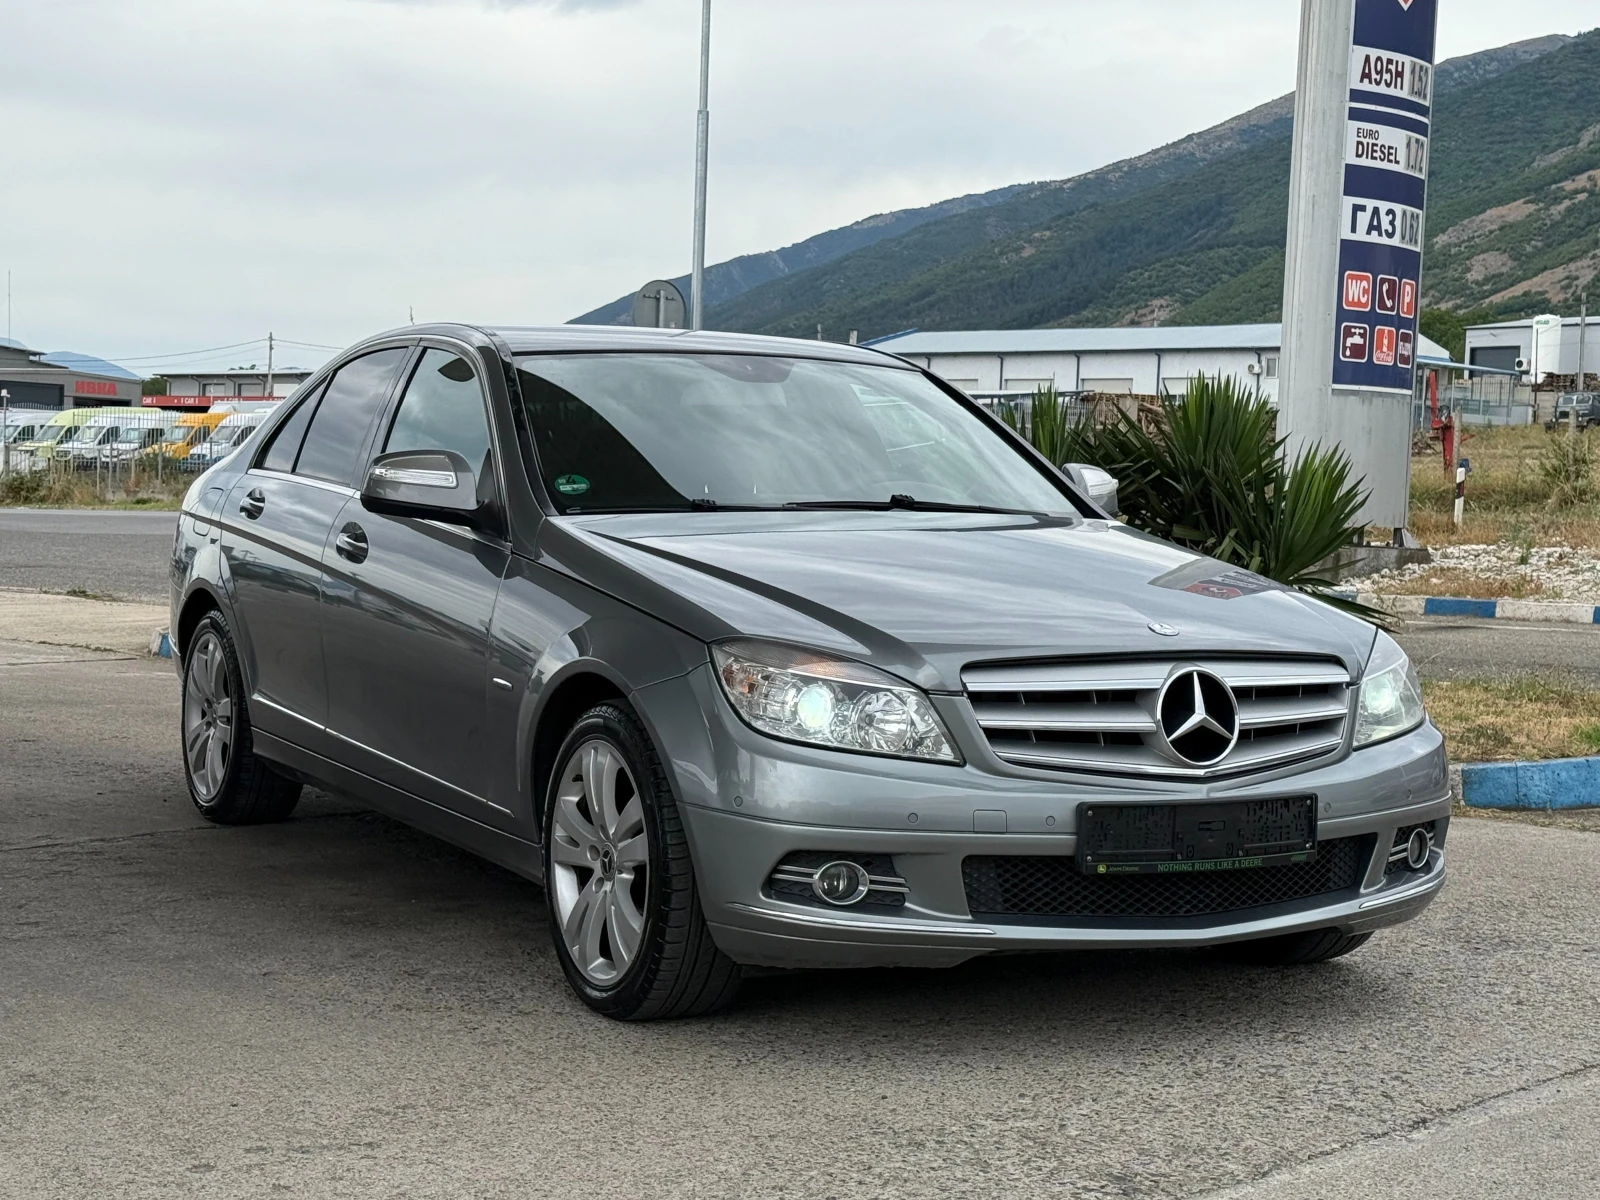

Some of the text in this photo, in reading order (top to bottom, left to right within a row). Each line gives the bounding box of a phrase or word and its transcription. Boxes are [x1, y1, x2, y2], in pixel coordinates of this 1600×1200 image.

[1356, 127, 1380, 141] EURO
[1355, 141, 1400, 165] DIESEL
[1350, 203, 1397, 239] ГАЗ
[1347, 279, 1368, 304] WC
[1157, 858, 1263, 872] NOTHING RUNS LIKE A DEERE
